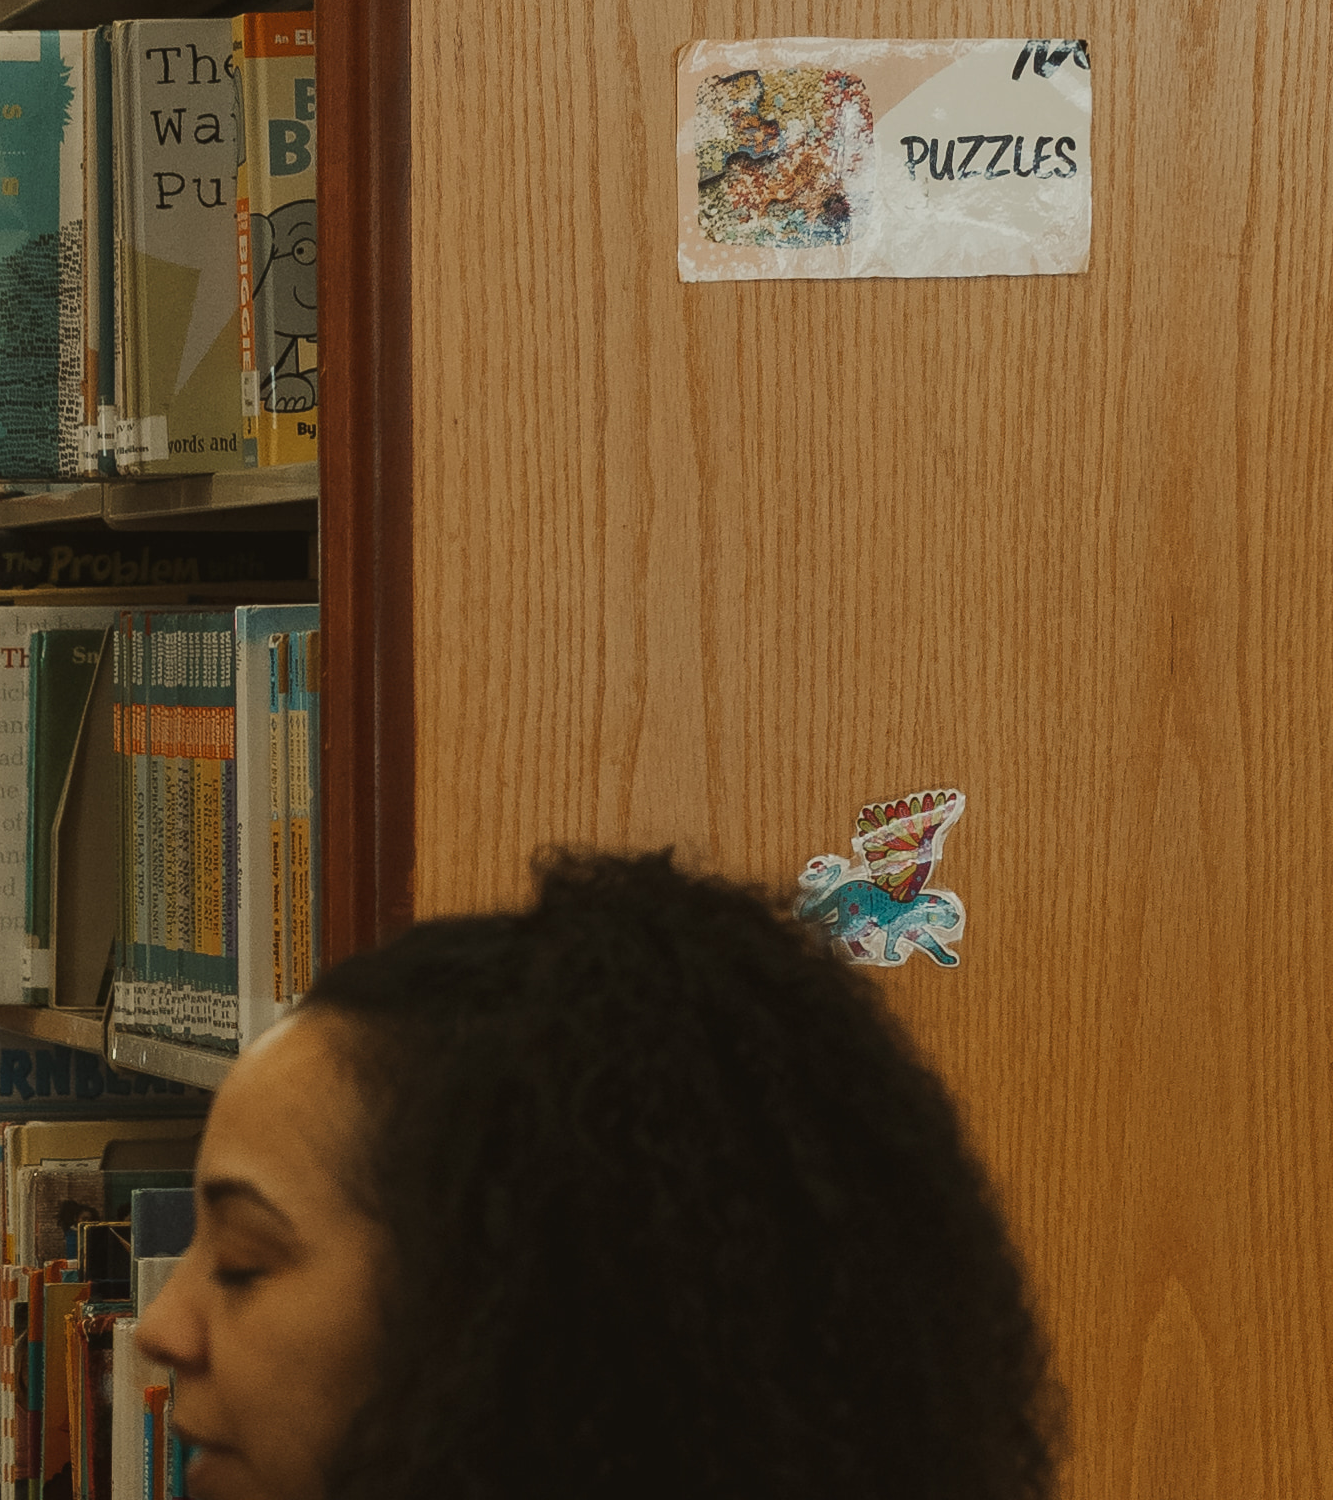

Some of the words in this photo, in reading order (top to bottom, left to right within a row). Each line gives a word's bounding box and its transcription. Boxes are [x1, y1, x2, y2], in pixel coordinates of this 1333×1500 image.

[274, 34, 289, 44] An
[899, 135, 1078, 182] PUZZLES
[297, 422, 317, 440] By
[210, 433, 238, 452] and
[3, 553, 42, 573] The
[49, 545, 200, 586] Problem
